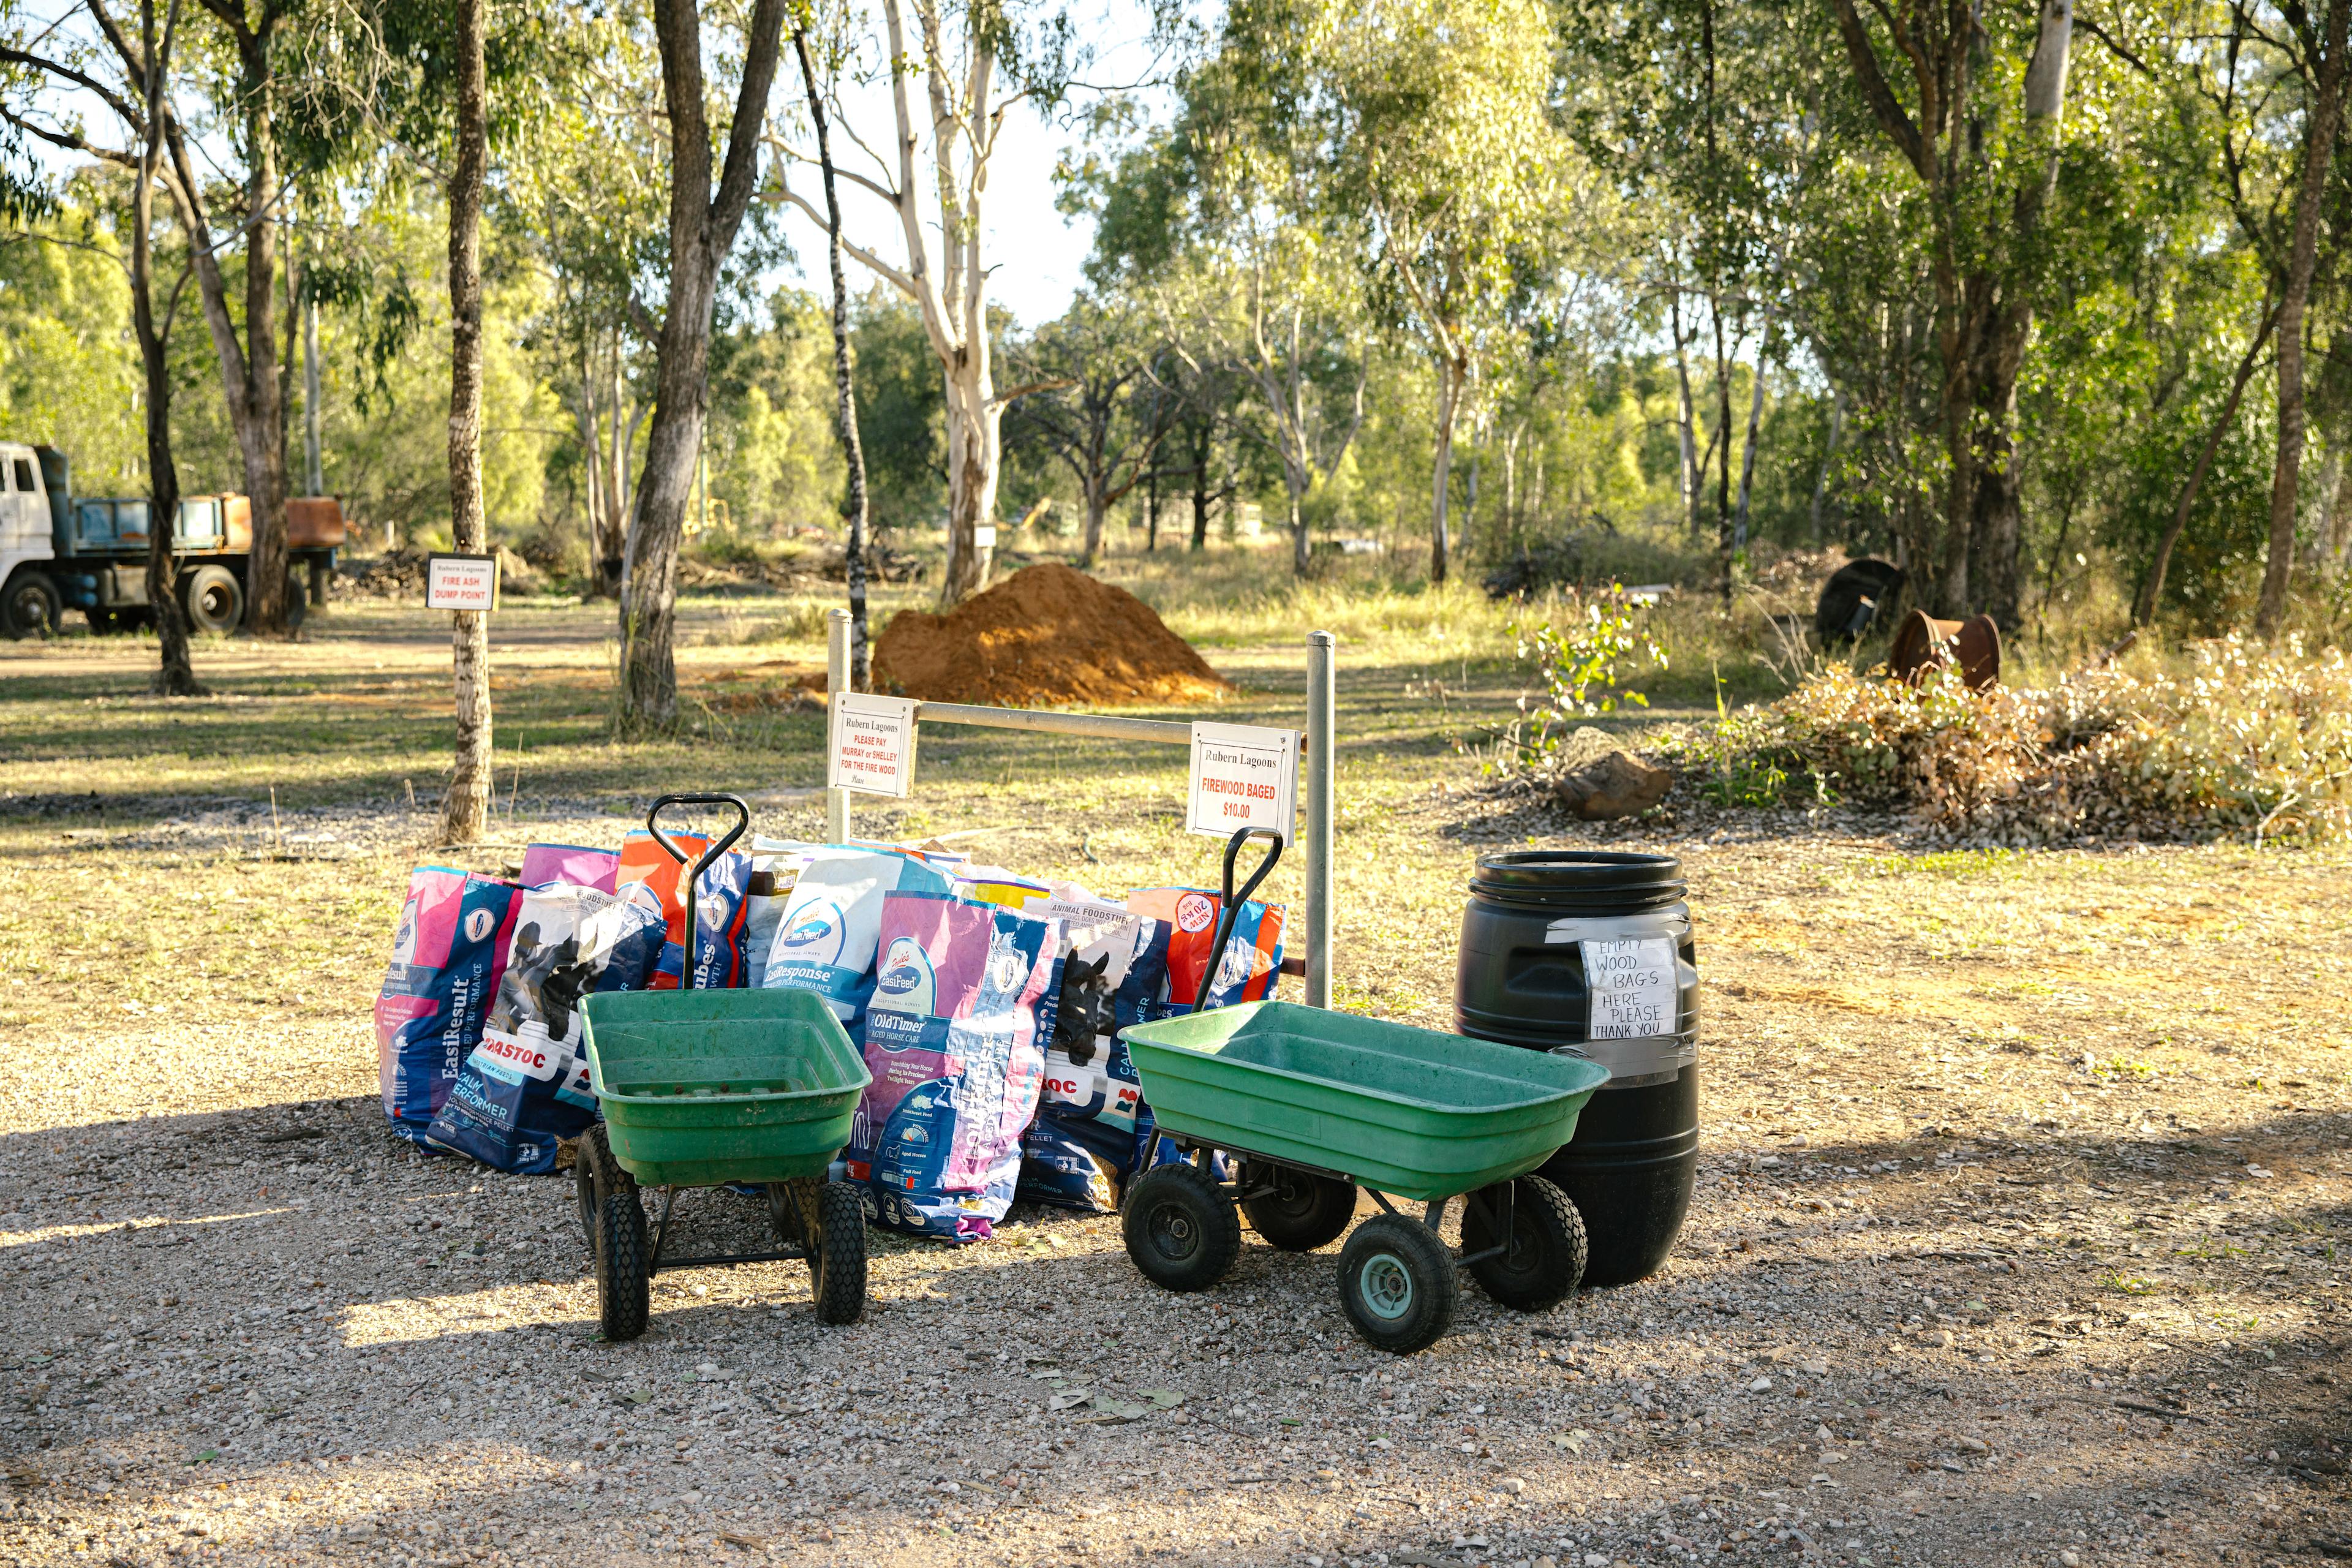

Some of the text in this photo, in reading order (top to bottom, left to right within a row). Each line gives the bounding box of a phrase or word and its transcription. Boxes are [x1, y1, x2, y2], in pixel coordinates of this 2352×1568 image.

[442, 577, 461, 586] FIRE
[846, 718, 898, 733] Rubern Lagoons
[854, 735, 887, 747] PLEASE PAY
[842, 747, 865, 758] MURRAY
[872, 751, 897, 762] SHELLEY
[1205, 750, 1276, 769] Rubern Lagoons
[842, 760, 895, 775] FOR THE FIRE WOOD
[851, 774, 865, 784] Please
[1202, 777, 1275, 800] FIREWOOD BAGED
[1223, 802, 1250, 818] $10.00
[1182, 900, 1193, 910] Bag
[1052, 904, 1128, 925] ANIMAL FOODSTUFF
[1189, 912, 1210, 929] NEW
[1595, 956, 1637, 970] WOOD
[764, 966, 831, 982] EasiResponse
[881, 974, 915, 989] EasiFeed
[1613, 971, 1659, 989] BAGS
[782, 979, 832, 993] PERFORMANCE
[464, 963, 481, 1031] PERFORMANCE
[1603, 992, 1642, 1008] HERE
[1610, 1005, 1664, 1022] PLEASE
[442, 979, 469, 1079] EasiResult
[875, 1014, 925, 1033] OldTimer
[1594, 1022, 1660, 1038] THANK YOU
[886, 1033, 905, 1041] HORSE
[891, 1061, 910, 1069] Nourishing
[458, 1072, 484, 1091] CALM
[496, 1069, 512, 1079] FEEDS
[453, 1084, 507, 1120] ERFORMER
[459, 1101, 492, 1125] PERFORMANCE
[494, 1120, 514, 1132] PELLET
[913, 1123, 929, 1143] POWERFUL
